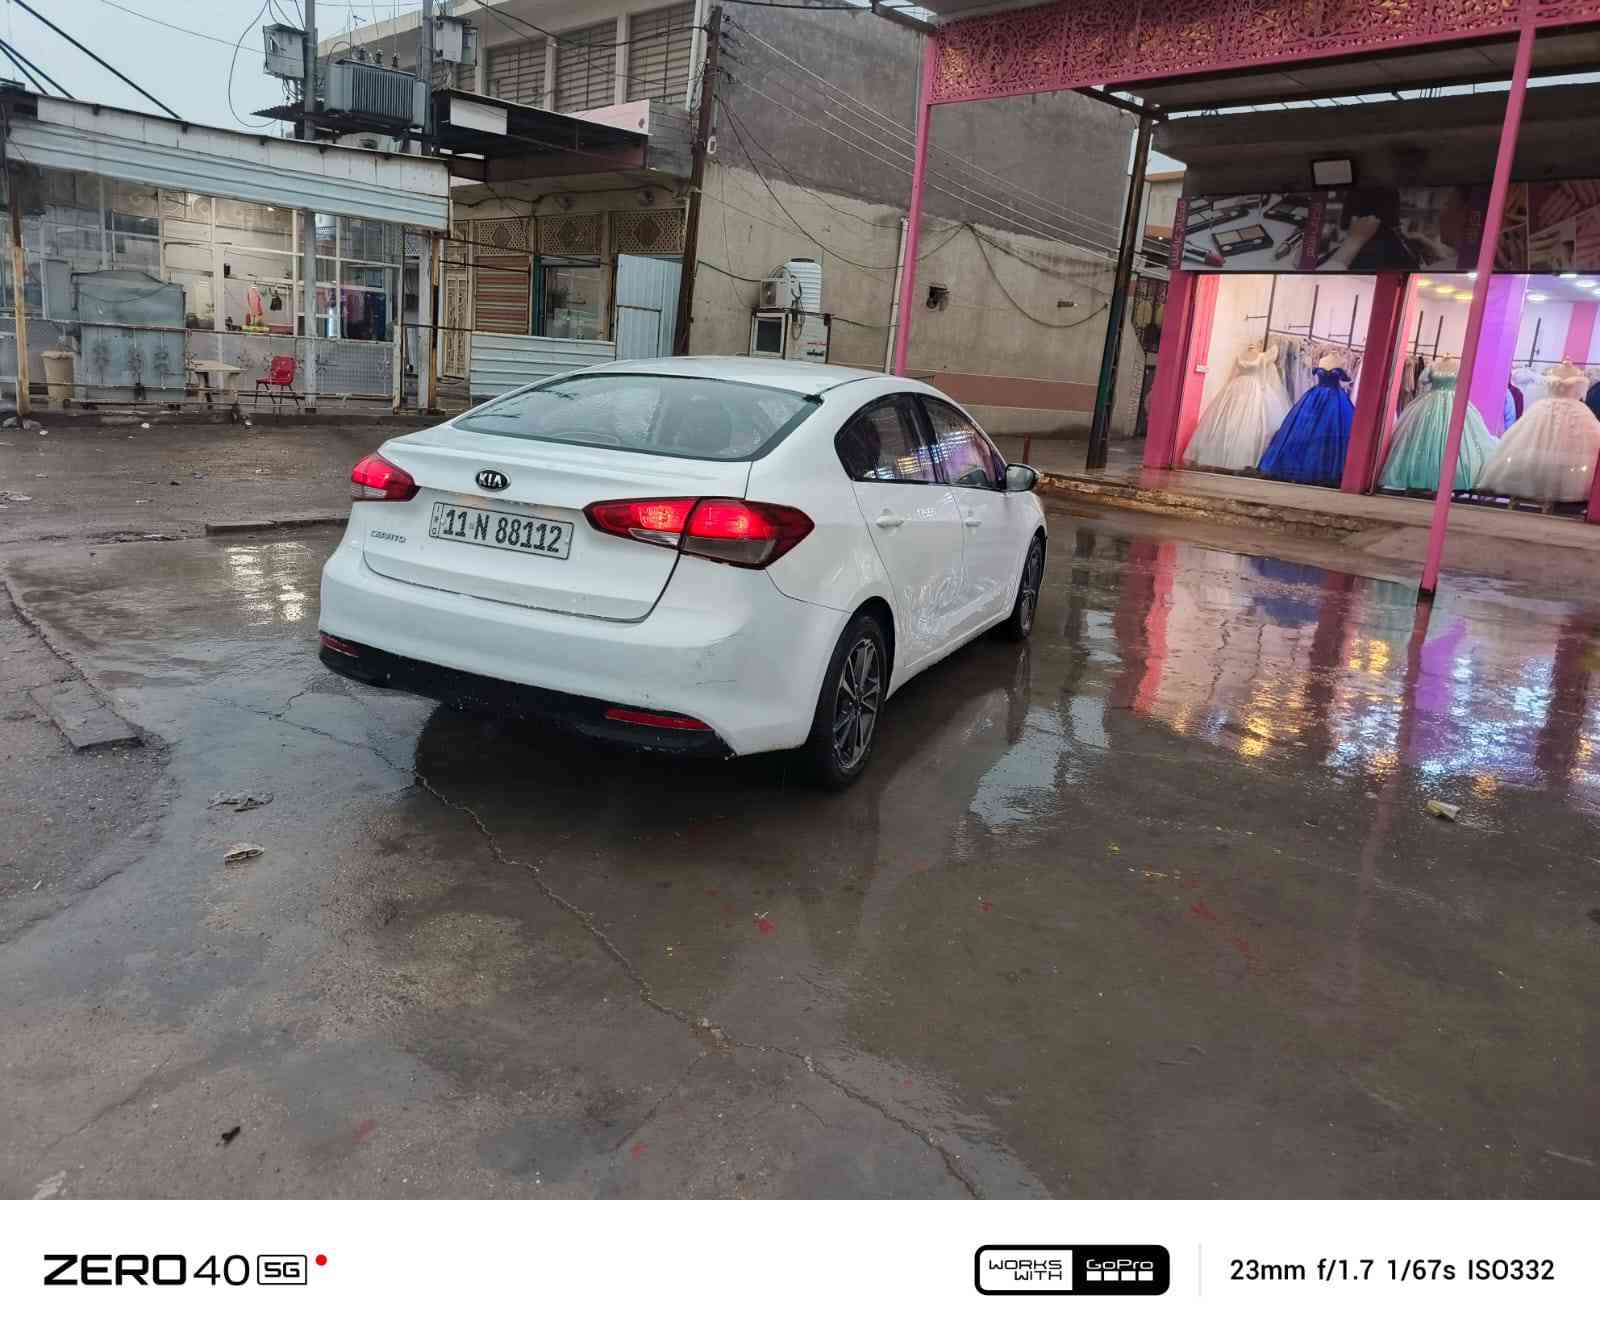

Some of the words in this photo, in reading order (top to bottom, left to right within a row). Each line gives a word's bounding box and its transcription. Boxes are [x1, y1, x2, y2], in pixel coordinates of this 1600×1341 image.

[479, 472, 503, 488] KIA
[443, 509, 468, 537] 11
[474, 512, 490, 541] N
[495, 516, 562, 553] 88112
